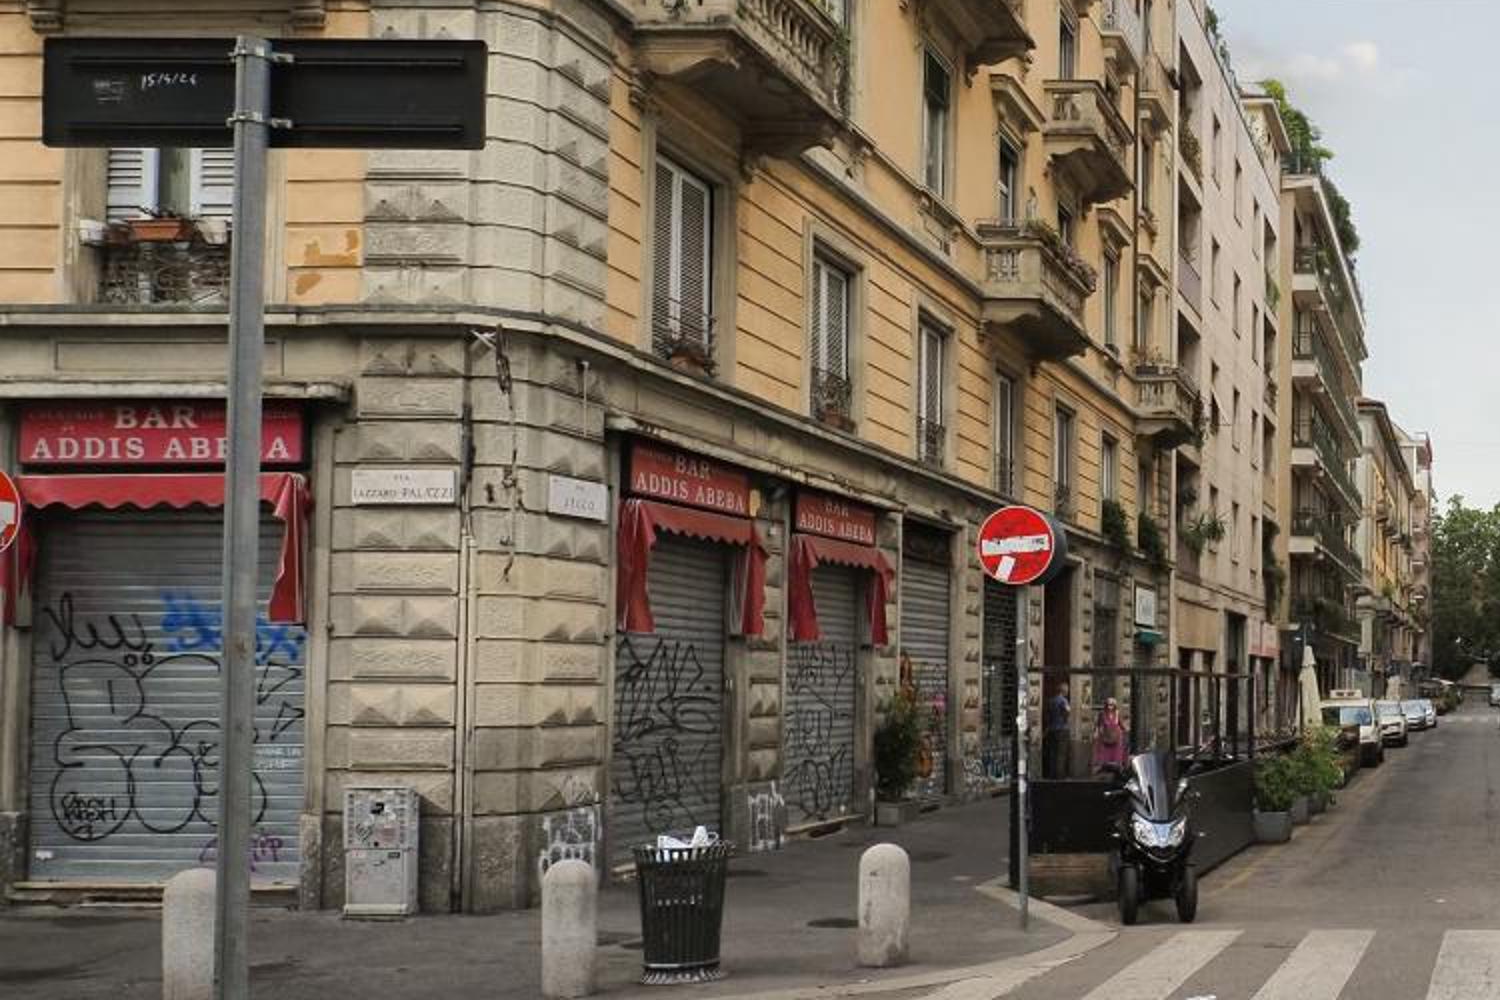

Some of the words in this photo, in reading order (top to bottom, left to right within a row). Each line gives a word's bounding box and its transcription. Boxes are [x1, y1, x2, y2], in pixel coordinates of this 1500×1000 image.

[114, 406, 198, 429] BAR
[31, 437, 145, 459] ADDIS
[162, 436, 290, 459] ABEA
[675, 455, 711, 480] BAR
[401, 487, 454, 498] PALAZZI
[635, 471, 689, 500] ADDIS
[694, 485, 746, 514] ABEBA
[799, 511, 835, 534] ADDIS
